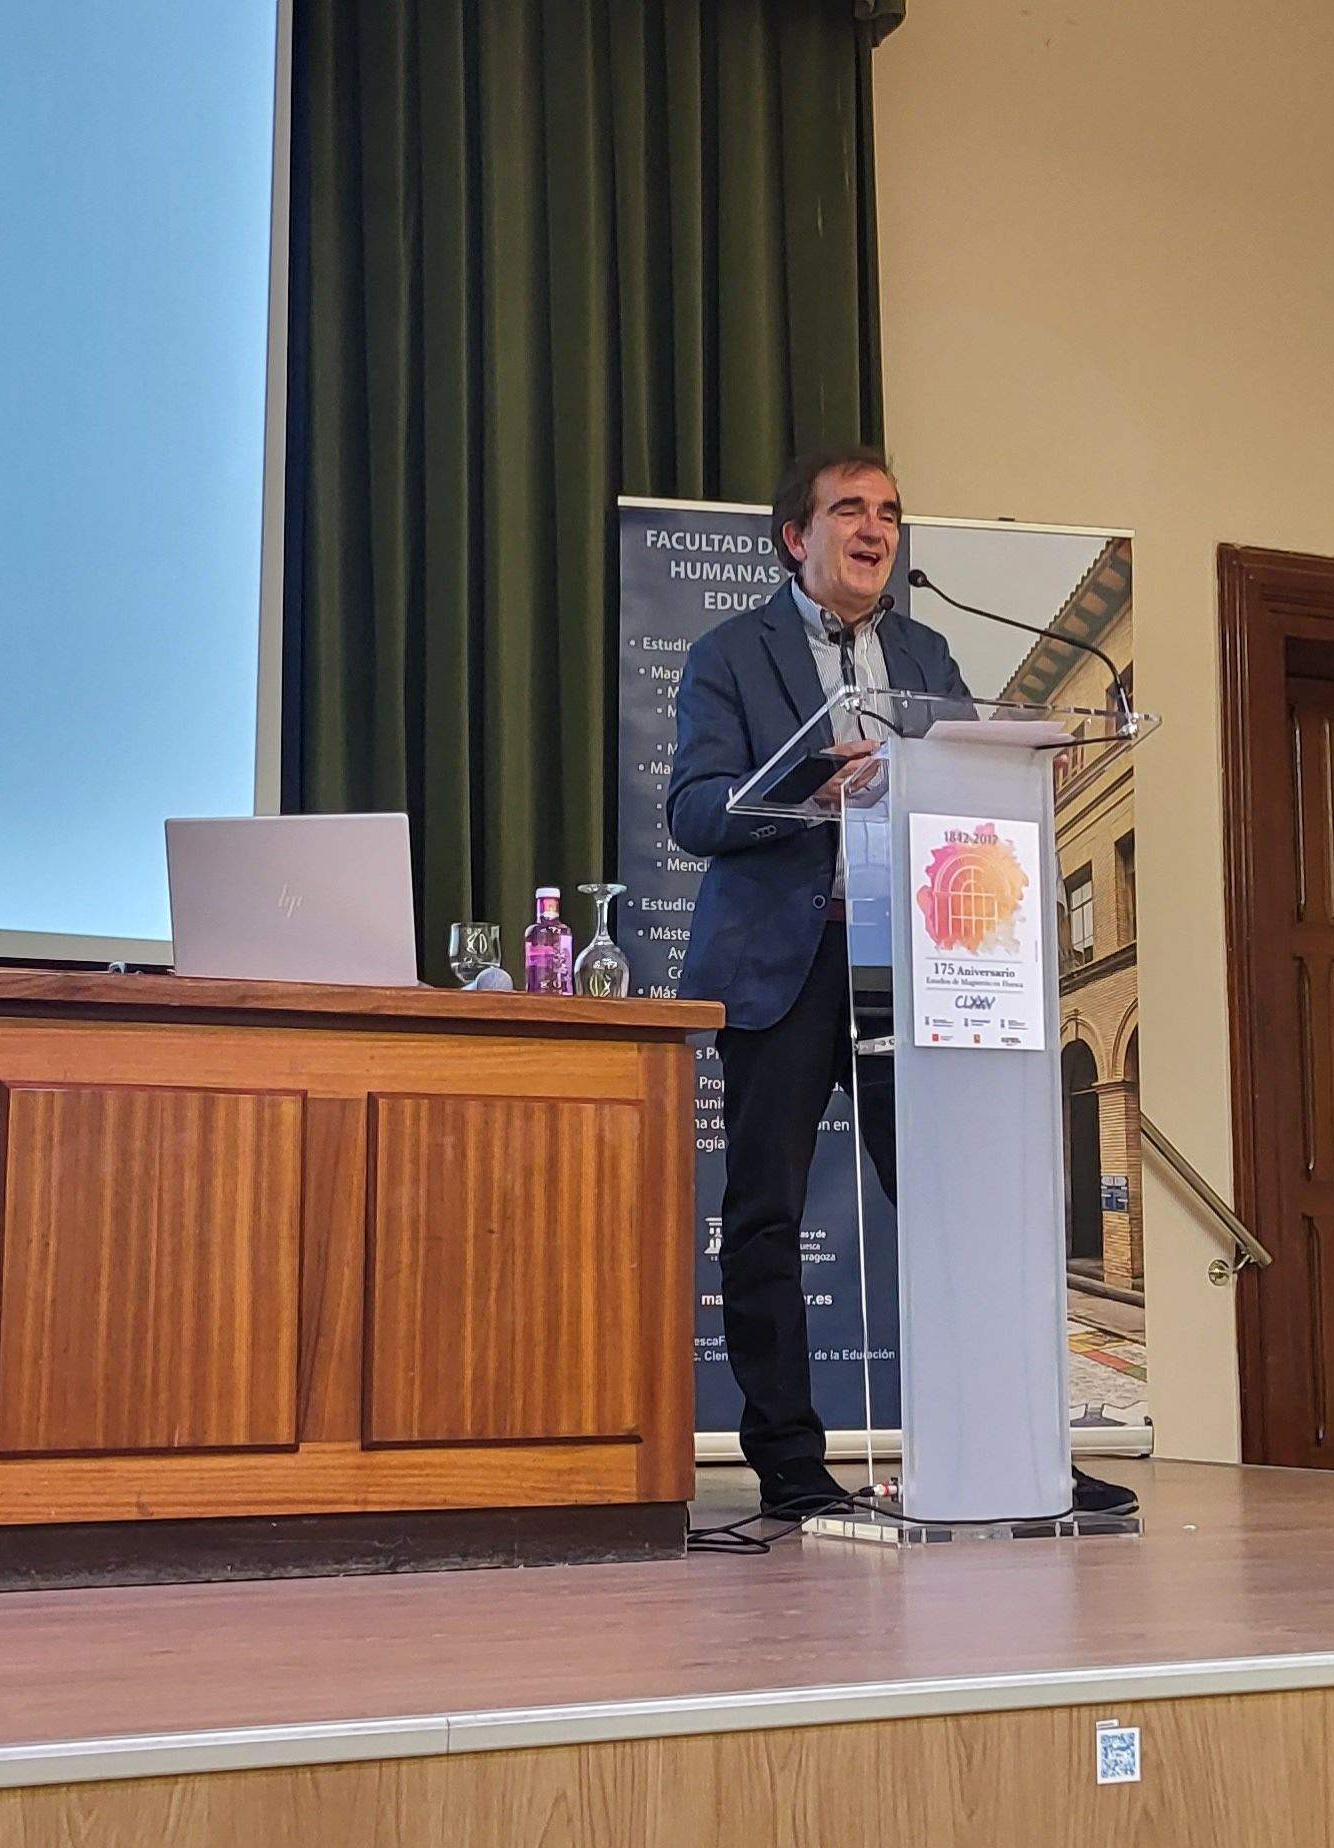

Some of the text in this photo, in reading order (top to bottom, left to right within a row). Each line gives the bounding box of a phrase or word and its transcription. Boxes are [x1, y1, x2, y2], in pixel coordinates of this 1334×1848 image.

[646, 530, 778, 554] FACULTAD D
[670, 560, 781, 583] HUMANAS
[704, 591, 773, 611] EDUC
[935, 962, 1015, 978] 175 Aniversario
[833, 1120, 849, 1131] en
